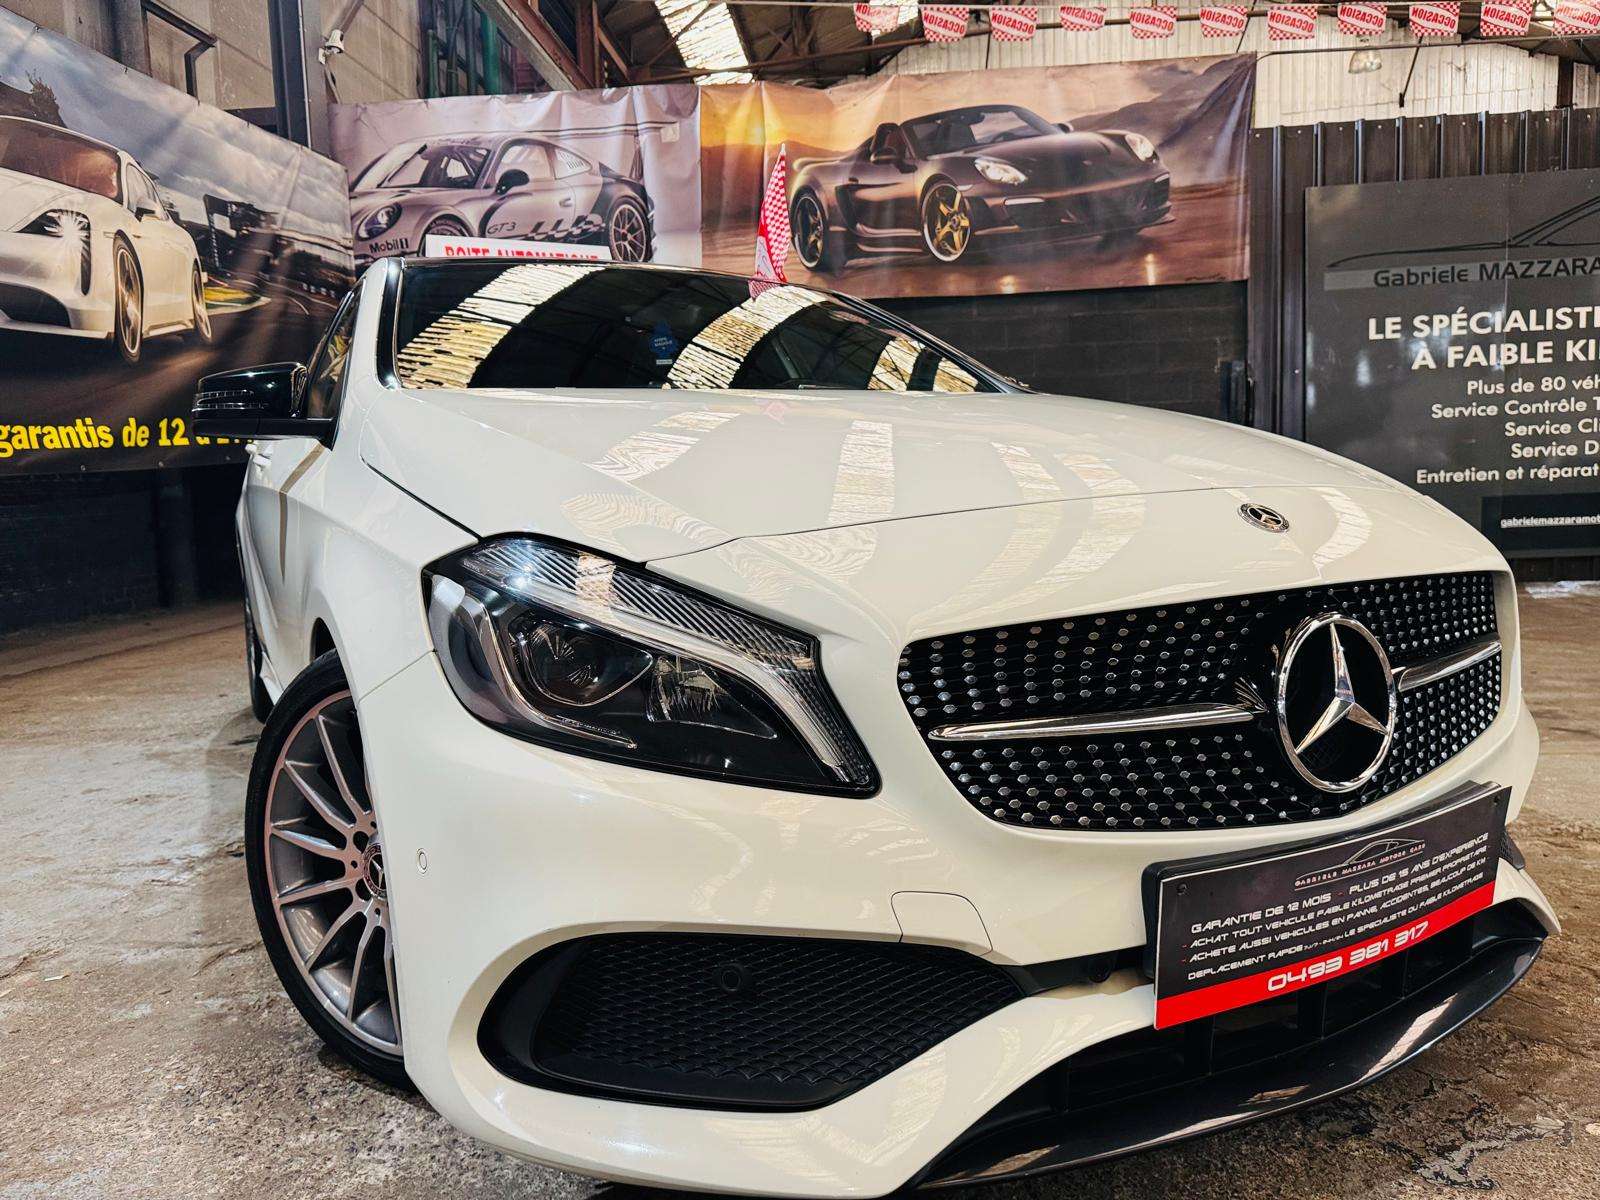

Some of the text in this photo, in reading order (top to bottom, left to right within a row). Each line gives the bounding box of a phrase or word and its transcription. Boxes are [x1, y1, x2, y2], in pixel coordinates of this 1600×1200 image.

[487, 222, 516, 235] GT3
[369, 239, 399, 254] Mobil
[1373, 256, 1600, 288] Gabriele MAZZARA
[1368, 317, 1402, 341] LE
[1447, 340, 1553, 369] FAIBLE
[1566, 339, 1600, 362] KI
[1467, 379, 1505, 396] Plus
[1510, 378, 1535, 393] de
[1541, 376, 1566, 392] 80
[1431, 402, 1499, 419] Service
[1504, 397, 1587, 415] Contrôle
[0, 417, 190, 458] garantis de 12
[1504, 420, 1572, 437] Service
[1511, 441, 1578, 458] Service
[1416, 467, 1500, 484] Entretien
[1505, 466, 1525, 480] et
[1189, 945, 1236, 963] ACHETE
[1239, 936, 1272, 951] AUSSI
[1274, 921, 1330, 941] VEHICULES
[1331, 916, 1345, 926] EN
[1430, 869, 1466, 889] BEAUCOUP
[1467, 863, 1476, 872] DE
[1476, 857, 1486, 867] KM
[1190, 846, 1487, 948] ACHAT TOUT VEHICULE FAIBLE KILOMETRAGE PREMIER PROPRIETAIRE
[1191, 911, 1261, 934] GARANTIE
[1265, 905, 1284, 918] DE
[1287, 902, 1299, 912] 12
[1302, 893, 1332, 909] MOIS
[1349, 879, 1380, 895] PLUS
[1381, 872, 1396, 884] DE
[1410, 859, 1431, 874] ANS
[1188, 955, 1266, 981] DEPLACEMENT
[1267, 944, 1304, 961] RAPIDE
[1344, 928, 1356, 938] LE
[1357, 909, 1407, 933] SPECIALISTE
[1407, 904, 1419, 914] DU
[1419, 893, 1442, 909] FAIBLE
[1267, 920, 1429, 991] 0493 381 317
